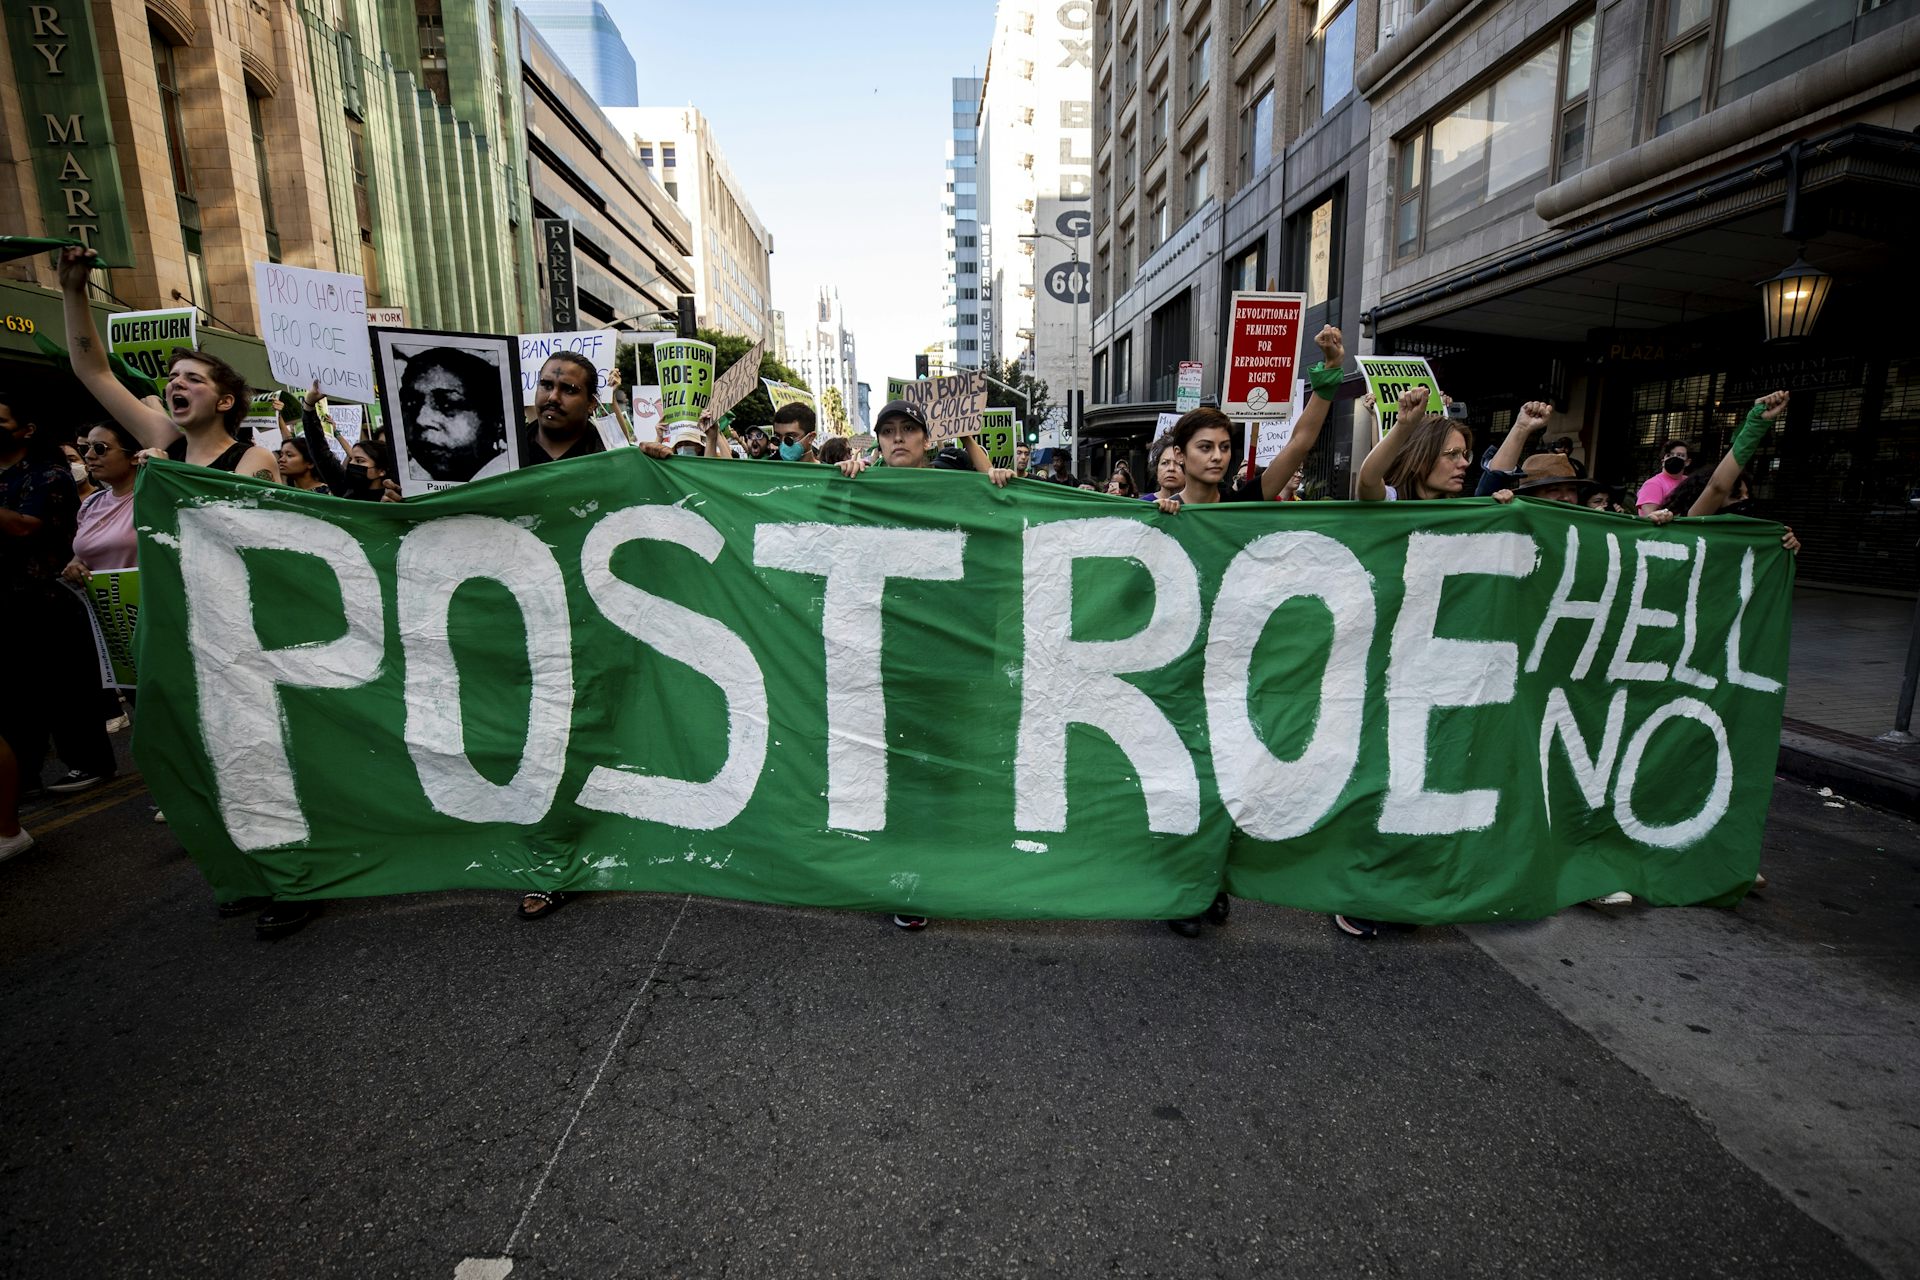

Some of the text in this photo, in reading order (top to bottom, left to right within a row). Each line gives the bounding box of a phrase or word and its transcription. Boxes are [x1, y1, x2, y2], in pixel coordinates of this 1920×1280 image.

[42, 113, 98, 250] MART
[980, 223, 991, 298] WESTERN
[550, 226, 570, 324] PARKING
[266, 267, 364, 314] PRO CHOICE
[367, 313, 402, 324] EW YORK
[1236, 308, 1299, 320] REVOLUTIONARY
[111, 318, 190, 343] OVERTURN
[271, 312, 346, 355] PRO ROE
[1246, 324, 1287, 336] FEMINISTS
[569, 336, 604, 360] OFF
[656, 346, 712, 365] OVERTURN
[1257, 340, 1273, 352] FOR
[1610, 344, 1665, 361] PLAZA
[273, 350, 369, 390] PRO WOMEN
[1234, 356, 1292, 368] REPRODUCTIVE
[1364, 363, 1430, 377] OVERTURN
[662, 365, 707, 386] ROE ?
[905, 382, 932, 404] OUR
[936, 371, 986, 399] BODIES
[1248, 372, 1276, 383] RIGHTS
[1791, 370, 1847, 388] CENTER
[663, 390, 686, 409] HELL
[931, 394, 980, 420] CHOICE
[937, 414, 982, 439] SCOTUS
[110, 574, 120, 605] from
[1524, 524, 1783, 694] HELL
[177, 503, 1541, 851] POST ROE
[1539, 686, 1734, 848] NO
